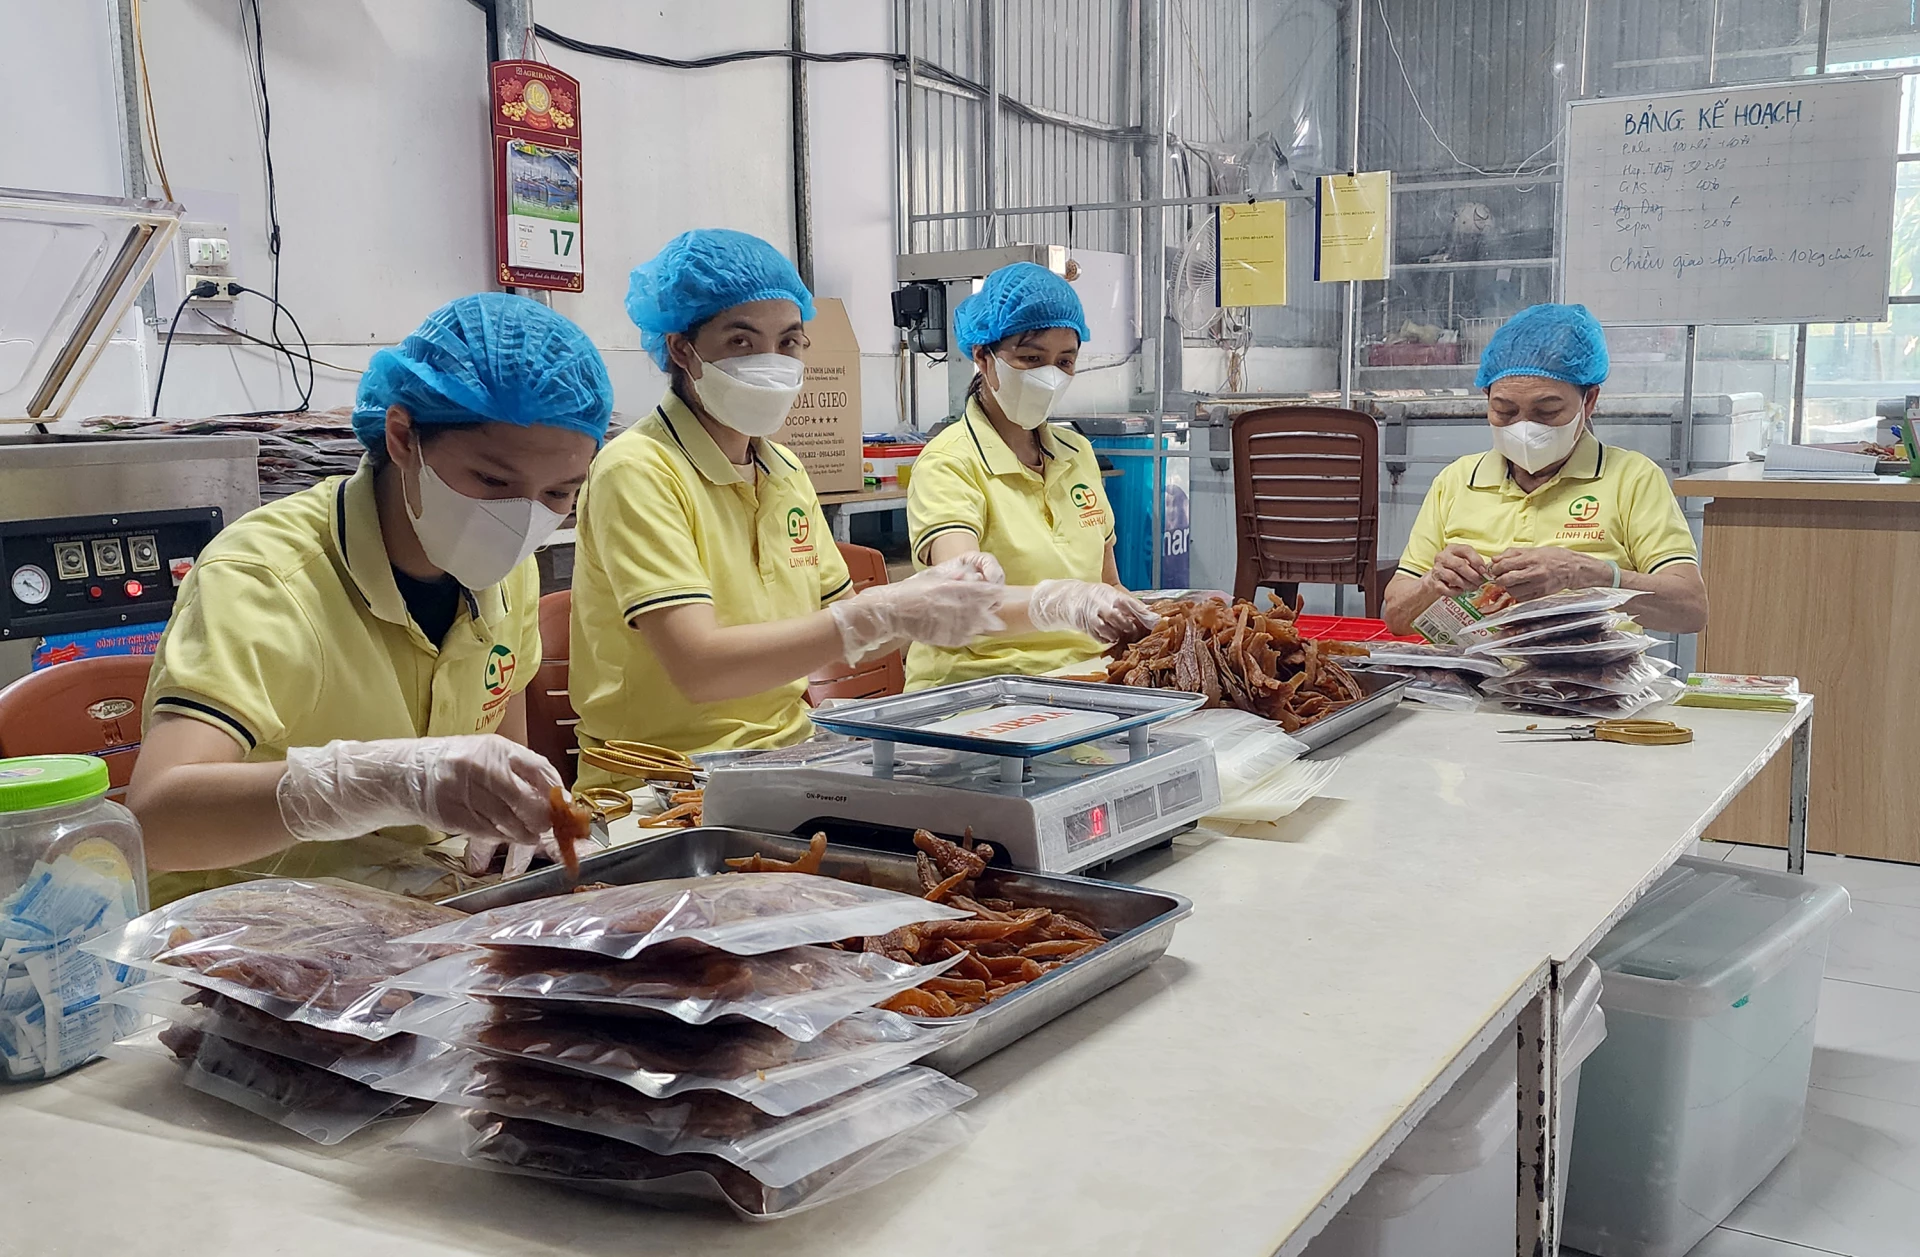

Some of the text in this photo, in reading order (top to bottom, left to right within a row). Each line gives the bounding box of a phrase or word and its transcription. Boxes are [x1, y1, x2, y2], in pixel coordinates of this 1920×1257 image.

[523, 70, 557, 82] AGRIBANK
[1625, 98, 1802, 135] BẢNG KẾ HOẠCH
[549, 228, 575, 257] 17
[818, 391, 847, 408] GIEO
[785, 415, 810, 427] OCOP
[1556, 529, 1605, 541] LINH HUỆ
[1442, 596, 1469, 621] KHOAI
[962, 711, 1075, 738] VICHITA
